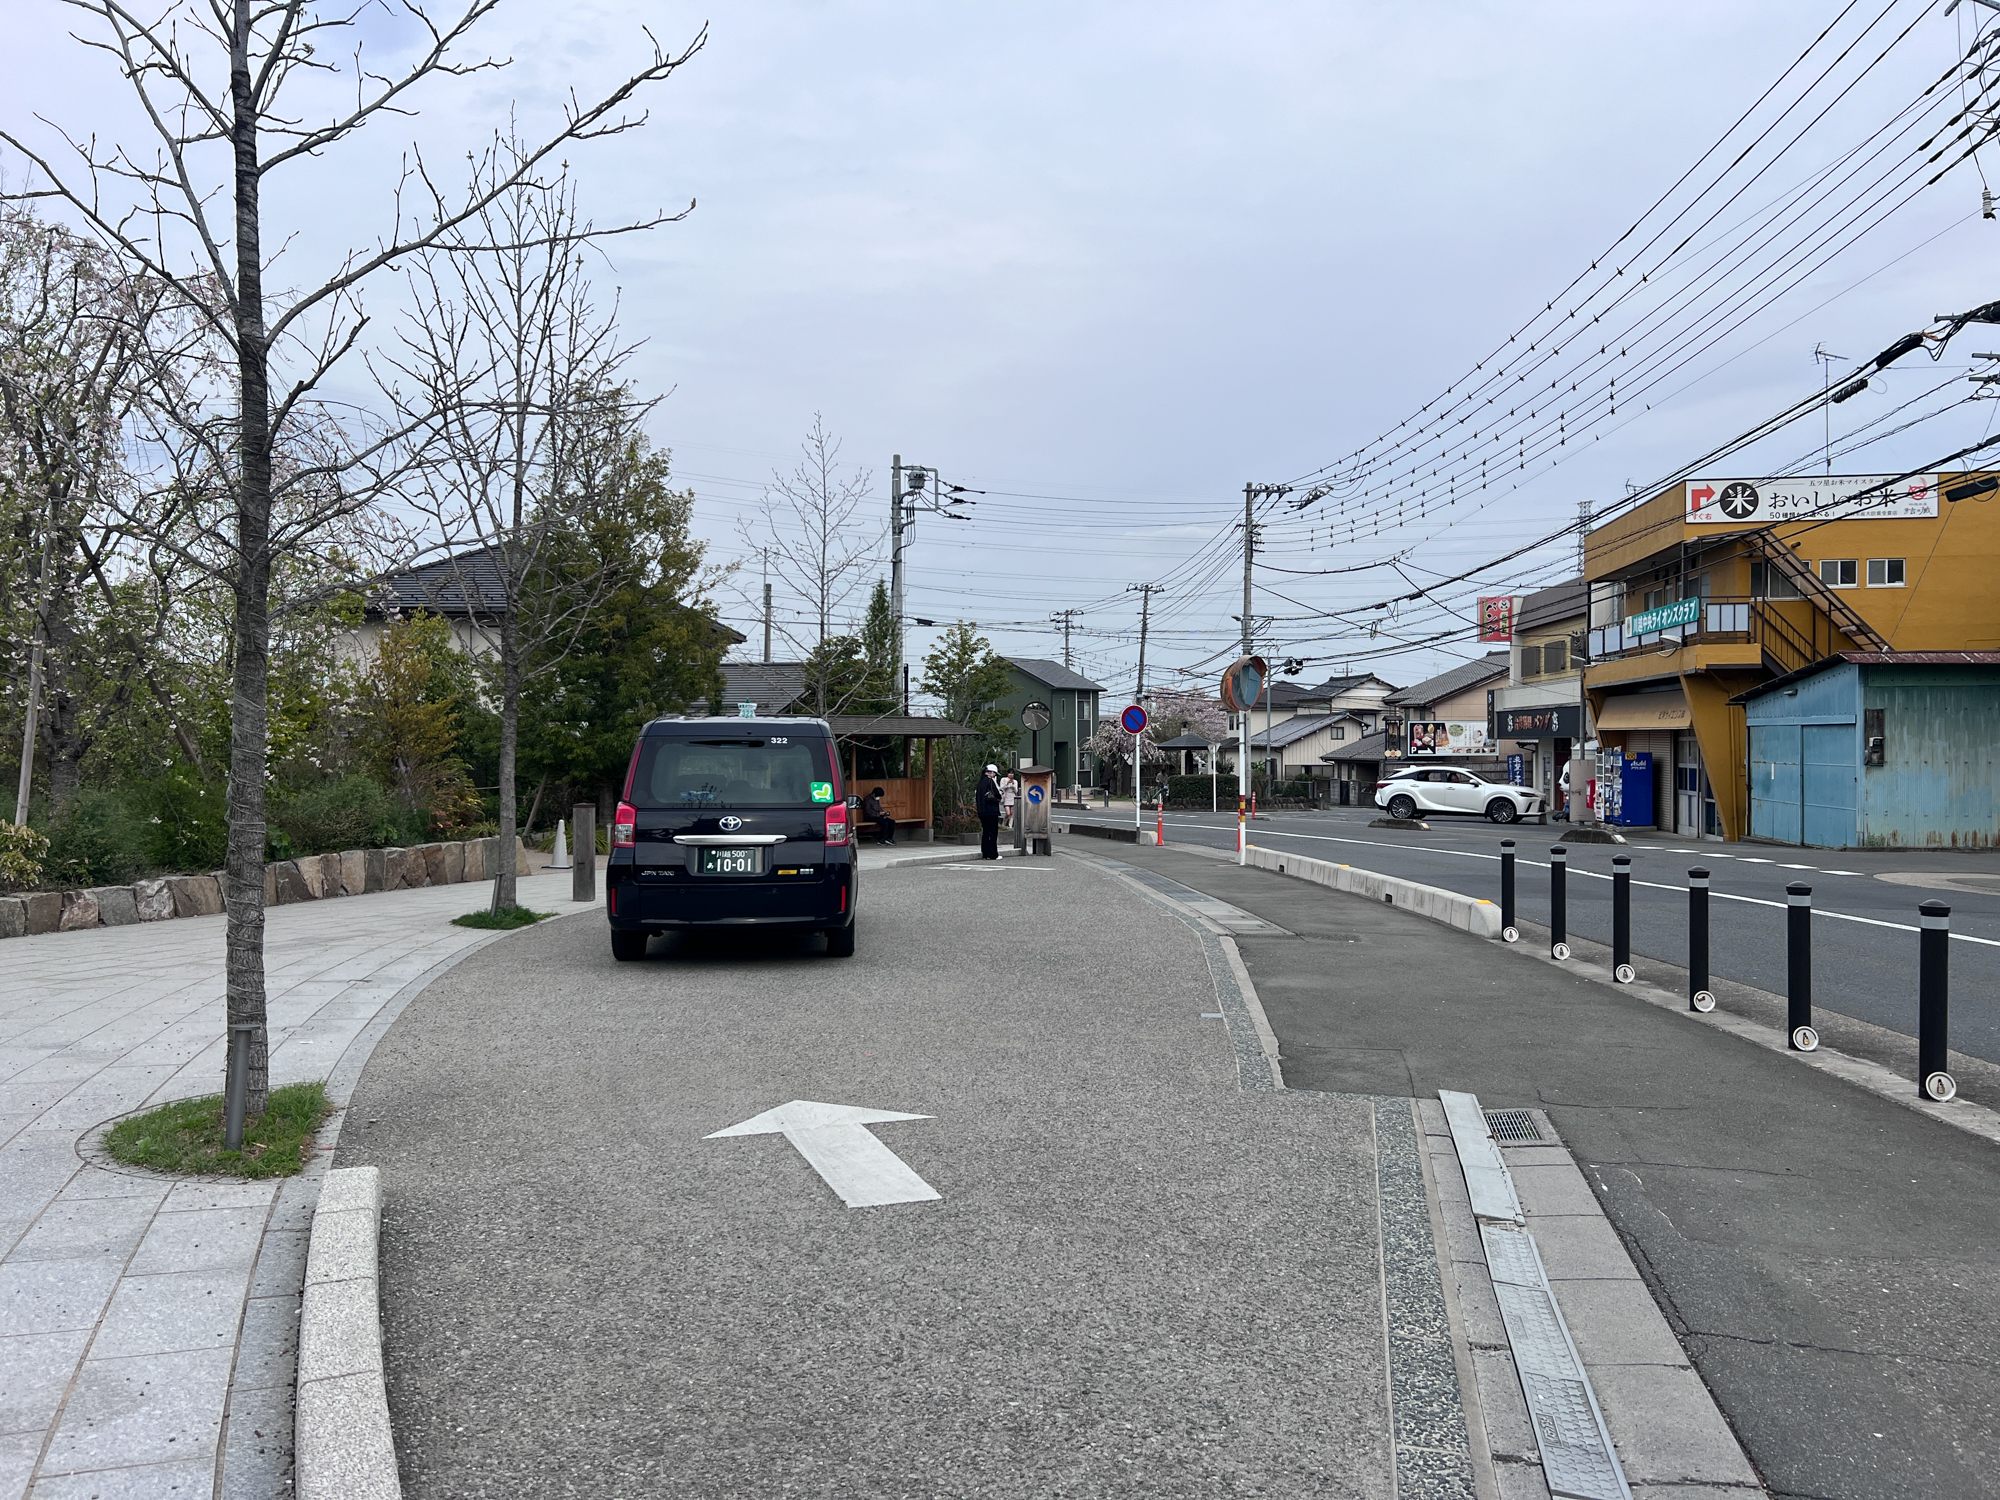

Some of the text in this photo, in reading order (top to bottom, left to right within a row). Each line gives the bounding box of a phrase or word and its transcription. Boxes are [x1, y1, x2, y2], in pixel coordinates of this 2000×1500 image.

[1809, 477, 1895, 486] 五ツ星お米マイスター
[1725, 486, 1754, 514] 米
[1768, 488, 1898, 510] おいしいお米
[1692, 512, 1713, 521] すぐ右
[1485, 602, 1498, 638] パンダ
[1633, 600, 1696, 633] 川越中央ライオンズクラブ
[741, 709, 754, 718] 322
[1411, 746, 1417, 754] P
[716, 850, 745, 858] 川越 500
[716, 858, 751, 872] 10-01
